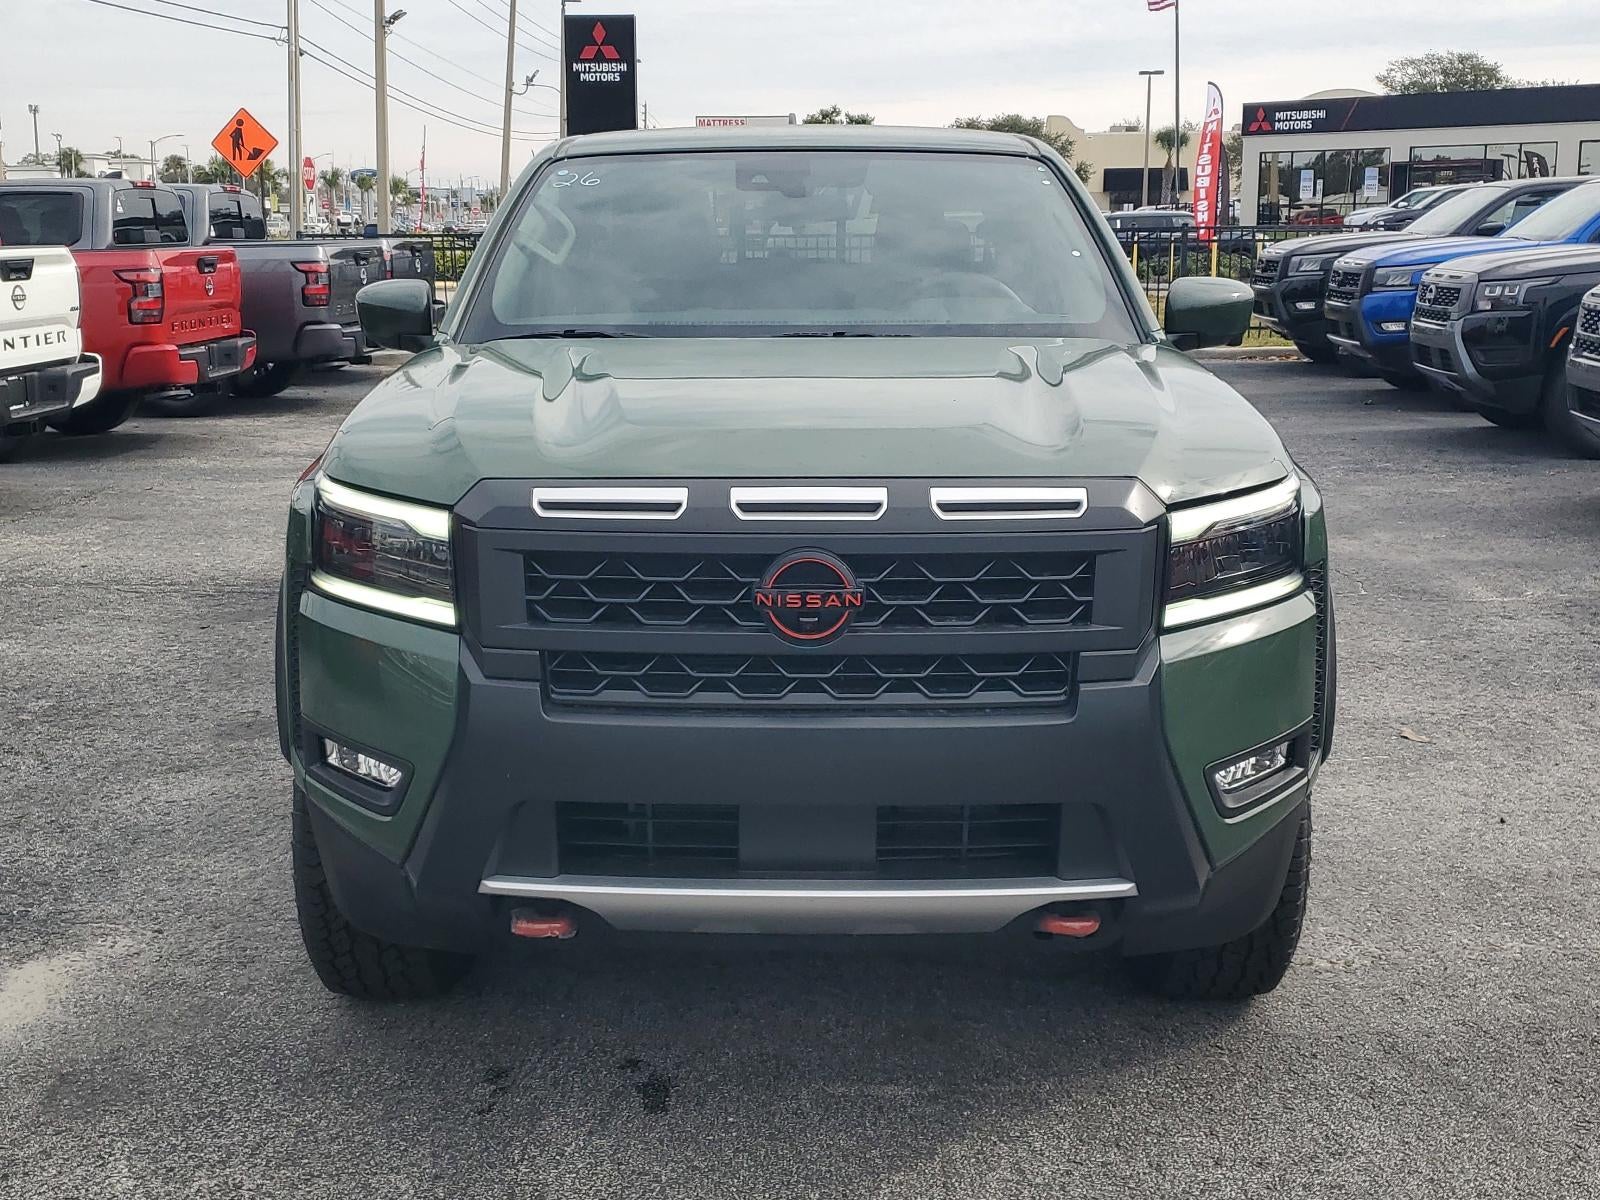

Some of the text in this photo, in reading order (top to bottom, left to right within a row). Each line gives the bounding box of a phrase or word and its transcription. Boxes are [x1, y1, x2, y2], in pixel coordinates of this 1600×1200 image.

[572, 62, 627, 72] MITSUBISHI
[580, 72, 621, 82] MOTORS
[1275, 109, 1326, 120] MITSUBISHI
[698, 118, 745, 127] MATTRESS
[1274, 120, 1313, 131] MOTORS
[552, 170, 601, 188] 26
[171, 313, 233, 333] FRONTIER
[755, 592, 862, 608] NISSAN
